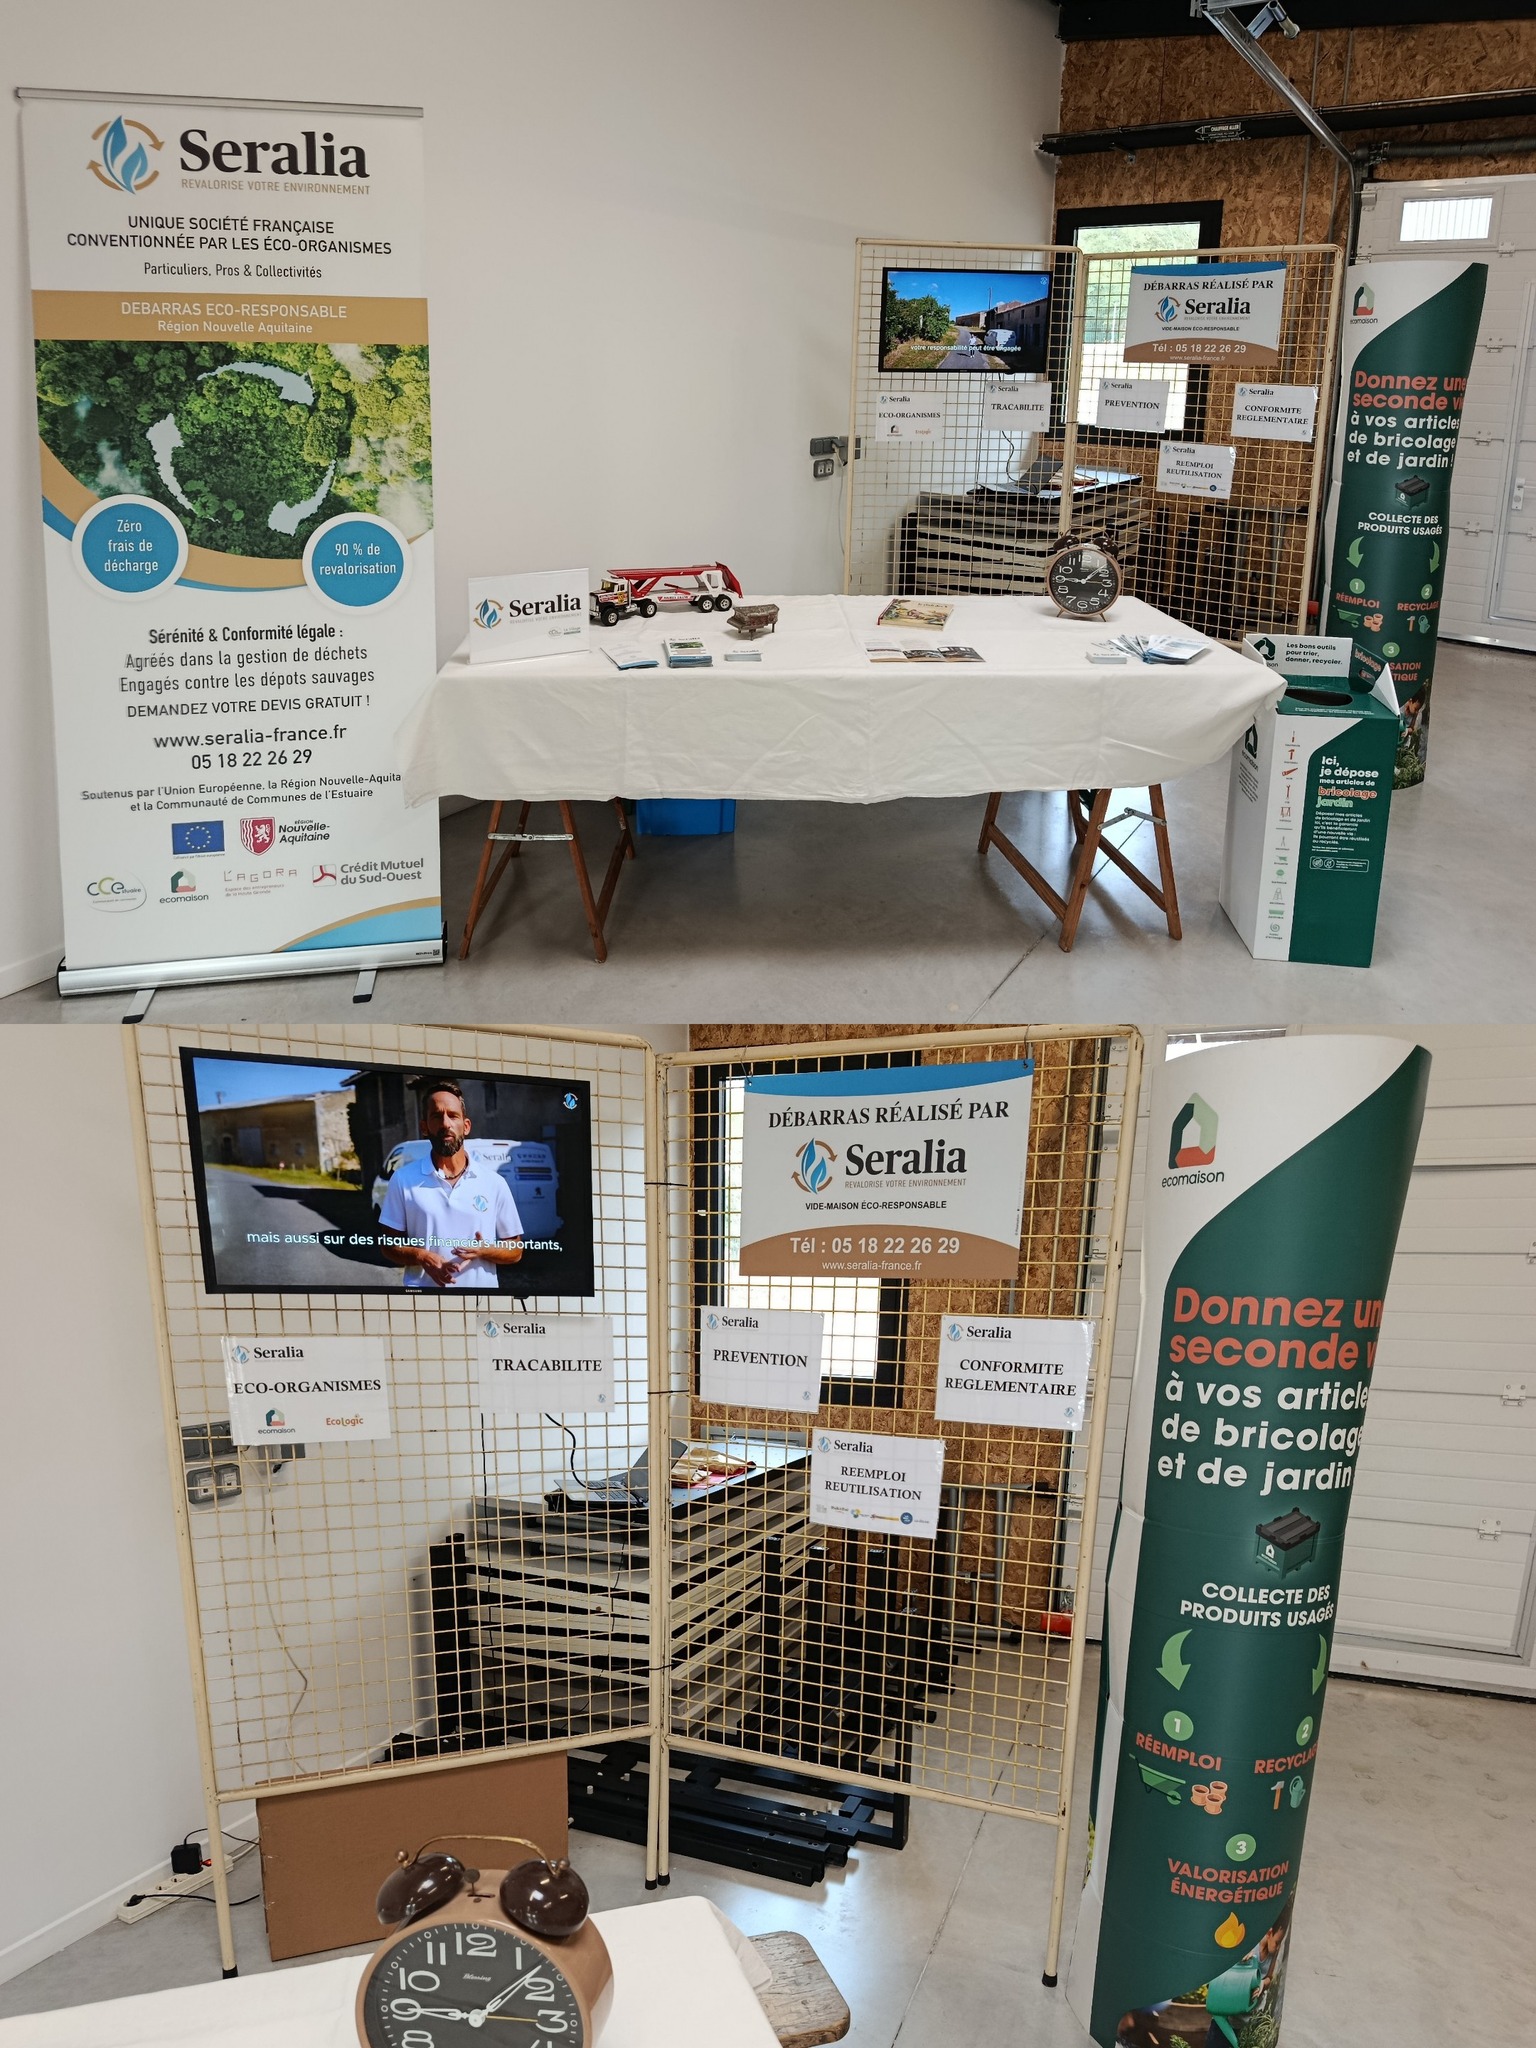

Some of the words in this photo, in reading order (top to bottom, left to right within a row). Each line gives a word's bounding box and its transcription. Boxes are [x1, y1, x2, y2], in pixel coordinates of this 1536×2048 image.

[179, 129, 370, 179] Seralia
[181, 179, 244, 191] REVALORISE
[248, 181, 279, 192] VOTRE
[283, 182, 371, 195] ENVIRONNEMENT
[128, 216, 184, 230] UNIQUE
[189, 215, 248, 232] SOCIÉTÉ
[253, 220, 334, 236] FRANÇAISE
[67, 232, 194, 249] CONVENTIONNÉE
[200, 237, 228, 250] PAR
[232, 238, 259, 251] LES
[264, 235, 392, 255] ÉCO-ORGANISMES
[216, 264, 240, 276] Pros
[244, 265, 252, 277] &
[256, 264, 322, 279] Collectivités
[1144, 280, 1199, 291] DÉBARRAS
[1202, 278, 1249, 289] RÉALISÉ
[1252, 280, 1273, 289] PAR
[121, 302, 201, 316] DEBARRAS
[206, 303, 347, 319] ECO-RESPONSABLE
[1184, 297, 1250, 315] Seralia
[158, 321, 199, 334] Région
[204, 321, 254, 332] Nouvelle
[258, 322, 313, 334] Aquitaine
[1355, 371, 1437, 391] Donnez
[1105, 400, 1160, 409] PREVENTION
[1245, 405, 1301, 414] CONFORMITE
[1353, 393, 1448, 410] seconde
[1237, 414, 1309, 424] REGLEMENTAIRE
[1351, 411, 1359, 425] à
[1365, 414, 1397, 427] vos
[1404, 416, 1460, 430] articles
[1349, 431, 1368, 444] de
[1374, 432, 1456, 452] bricolage
[1176, 460, 1214, 469] REEMPLOI
[1347, 451, 1361, 462] et
[1366, 452, 1390, 466] de
[1397, 453, 1448, 469] jardin
[1166, 468, 1222, 479] REUTILISATION
[117, 519, 142, 533] Zéro
[1369, 512, 1422, 524] COLLECTE
[1424, 513, 1438, 524] DES
[1358, 522, 1410, 535] PRODUITS
[1413, 525, 1442, 535] USAGÉS
[108, 539, 135, 552] frais
[139, 540, 153, 552] de
[104, 559, 159, 574] décharge
[320, 562, 397, 575] revalorisation
[509, 594, 581, 617] Seralia
[1336, 592, 1380, 609] RÉEMPLOI
[149, 626, 204, 644] Sérénité
[208, 629, 218, 641] &
[222, 625, 293, 641] Conformité
[297, 624, 335, 641] légale
[127, 702, 208, 718] DEMANDEZ
[212, 700, 257, 714] VOTRE
[261, 698, 301, 712] DEVIS
[305, 696, 362, 709] GRATUIT
[154, 724, 347, 750] www.seralia-france.fr
[1322, 756, 1339, 767] Ici,
[1319, 766, 1332, 777] je
[1334, 767, 1379, 778] dépose
[82, 789, 134, 801] Soutenus
[136, 787, 155, 800] par
[158, 784, 195, 796] l'Union
[268, 780, 277, 790] la
[281, 778, 315, 791] Région
[319, 773, 401, 786] Nouvelle-Aquita
[1318, 786, 1377, 800] bricolage
[1316, 797, 1353, 807] jardin
[279, 822, 330, 833] Nouvelle-
[280, 831, 330, 844] Aquitaine
[340, 862, 377, 874] Crédit
[380, 858, 424, 872] Mutuel
[341, 873, 355, 884] du
[359, 871, 422, 883] Sud-Ouest
[159, 893, 209, 904] ecomaison
[768, 1107, 870, 1128] DÉBARRAS
[876, 1098, 963, 1122] RÉALISÉ
[968, 1101, 1009, 1119] PAR
[845, 1139, 967, 1176] Seralia
[845, 1180, 883, 1188] REVALORISE
[909, 1178, 966, 1187] ENVIRONNEMENT
[1162, 1170, 1224, 1188] ecomaison
[806, 1202, 859, 1210] VIDE-MAISON
[861, 1200, 947, 1210] ÉCO-RESPONSABLE
[247, 1231, 280, 1244] mais
[285, 1233, 319, 1244] aussi
[324, 1235, 345, 1245] sur
[349, 1234, 373, 1246] des
[378, 1234, 425, 1248] risques
[429, 1236, 490, 1249] financiers
[494, 1238, 563, 1252] importants,
[822, 1260, 922, 1271] www.seralia-france.fr
[1174, 1287, 1344, 1328] Donnez
[1354, 1300, 1384, 1329] un
[503, 1322, 546, 1335] Seralia
[722, 1316, 759, 1329] Seralia
[967, 1325, 1012, 1340] Seralia
[254, 1346, 304, 1359] Seralia
[713, 1349, 808, 1368] PREVENTION
[1169, 1333, 1358, 1370] seconde
[492, 1358, 602, 1372] TRACABILITE
[960, 1359, 1064, 1375] CONFORMITE
[234, 1379, 381, 1395] ECO-ORGANISMES
[945, 1377, 1077, 1396] REGLEMENTAIRE
[1165, 1371, 1184, 1402] à
[1196, 1381, 1262, 1408] vos
[1277, 1382, 1369, 1411] article
[1161, 1413, 1200, 1441] de
[834, 1439, 873, 1454] Seralia
[841, 1466, 906, 1482] REEMPLOI
[1158, 1453, 1186, 1480] et
[1197, 1458, 1248, 1487] de
[1260, 1461, 1351, 1496] jardin
[825, 1480, 922, 1501] REUTILISATION
[1202, 1582, 1303, 1605] COLLECTE
[1308, 1585, 1330, 1602] DES
[1180, 1600, 1281, 1627] PRODUITS
[1287, 1602, 1334, 1626] USAGÉS
[1136, 1732, 1222, 1771] RÉEMPLOI
[1254, 1744, 1318, 1774] RECYCLAG
[1168, 1857, 1289, 1884] VALORISATION
[1171, 1877, 1284, 1903] ÉNERGÉTIQUE
